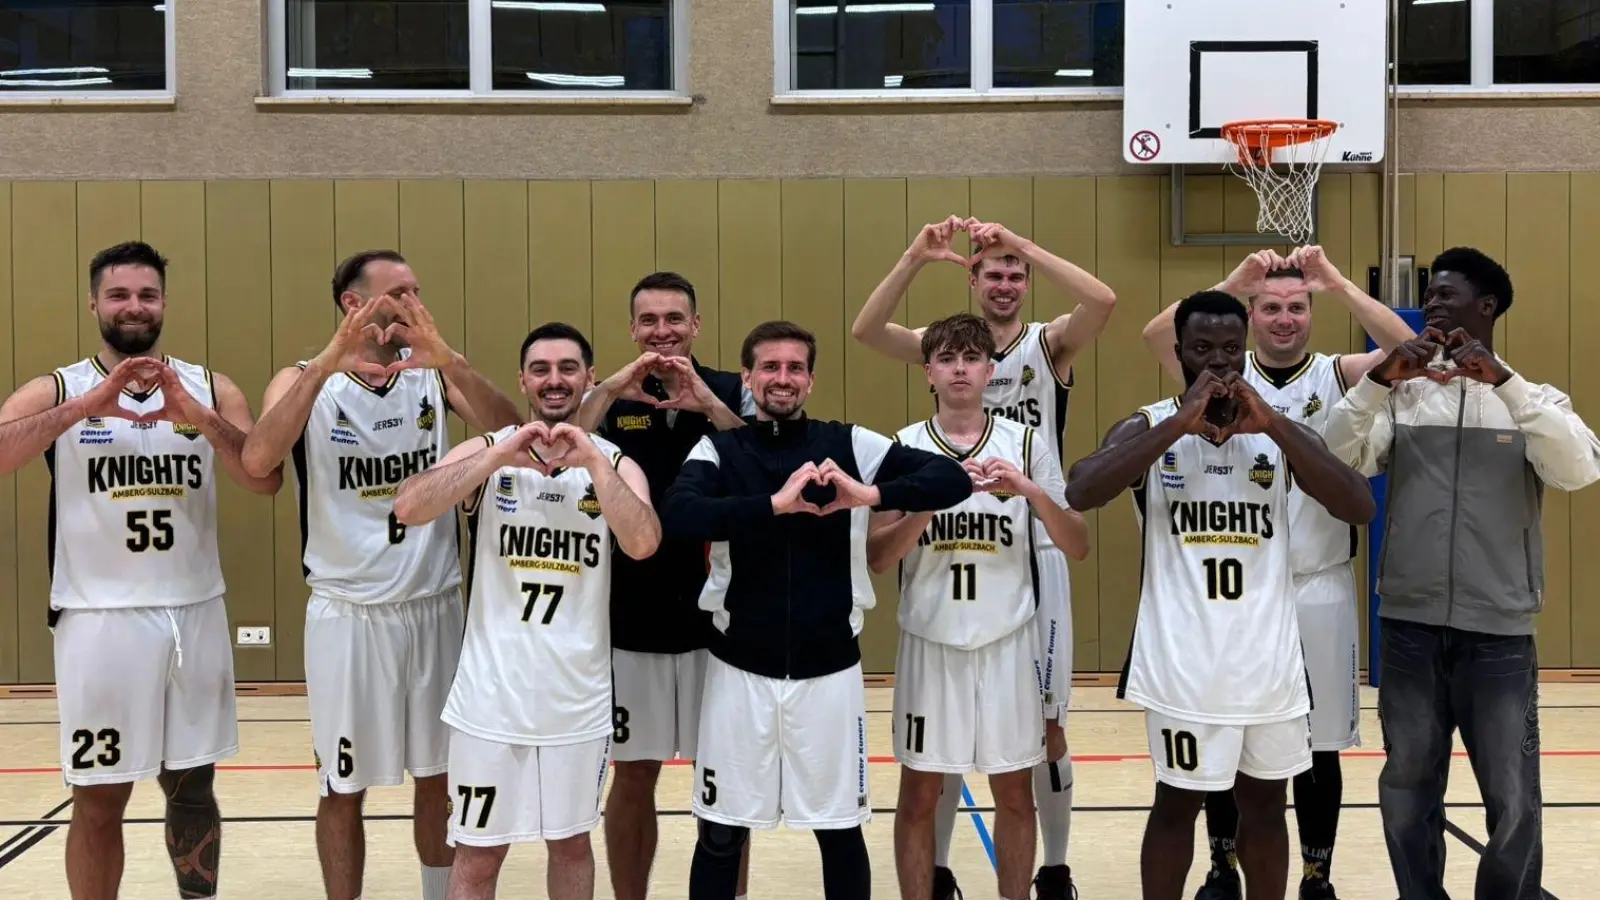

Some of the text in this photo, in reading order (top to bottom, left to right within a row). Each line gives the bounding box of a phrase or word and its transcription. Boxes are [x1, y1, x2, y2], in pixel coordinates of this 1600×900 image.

[1342, 151, 1372, 161] Kühne
[372, 417, 404, 431] JERS3Y
[88, 454, 202, 493] KNIGHTS
[1204, 465, 1234, 475] JERS3Y
[112, 488, 183, 499] AMBERG-SULZBACH
[536, 492, 566, 502] JERS3Y
[126, 510, 174, 552] 55
[1184, 534, 1258, 546] AMBERG-SULZBACH
[510, 559, 580, 574] AMBERG-SULZBACH
[950, 563, 976, 600] 11
[1202, 558, 1242, 600] 10
[521, 582, 564, 625] 77
[613, 706, 630, 744] 8
[906, 713, 926, 754] 11
[72, 728, 121, 770] 23
[338, 736, 354, 778] 6
[1161, 728, 1198, 772] 10
[702, 767, 718, 806] 5
[458, 785, 496, 829] 77
